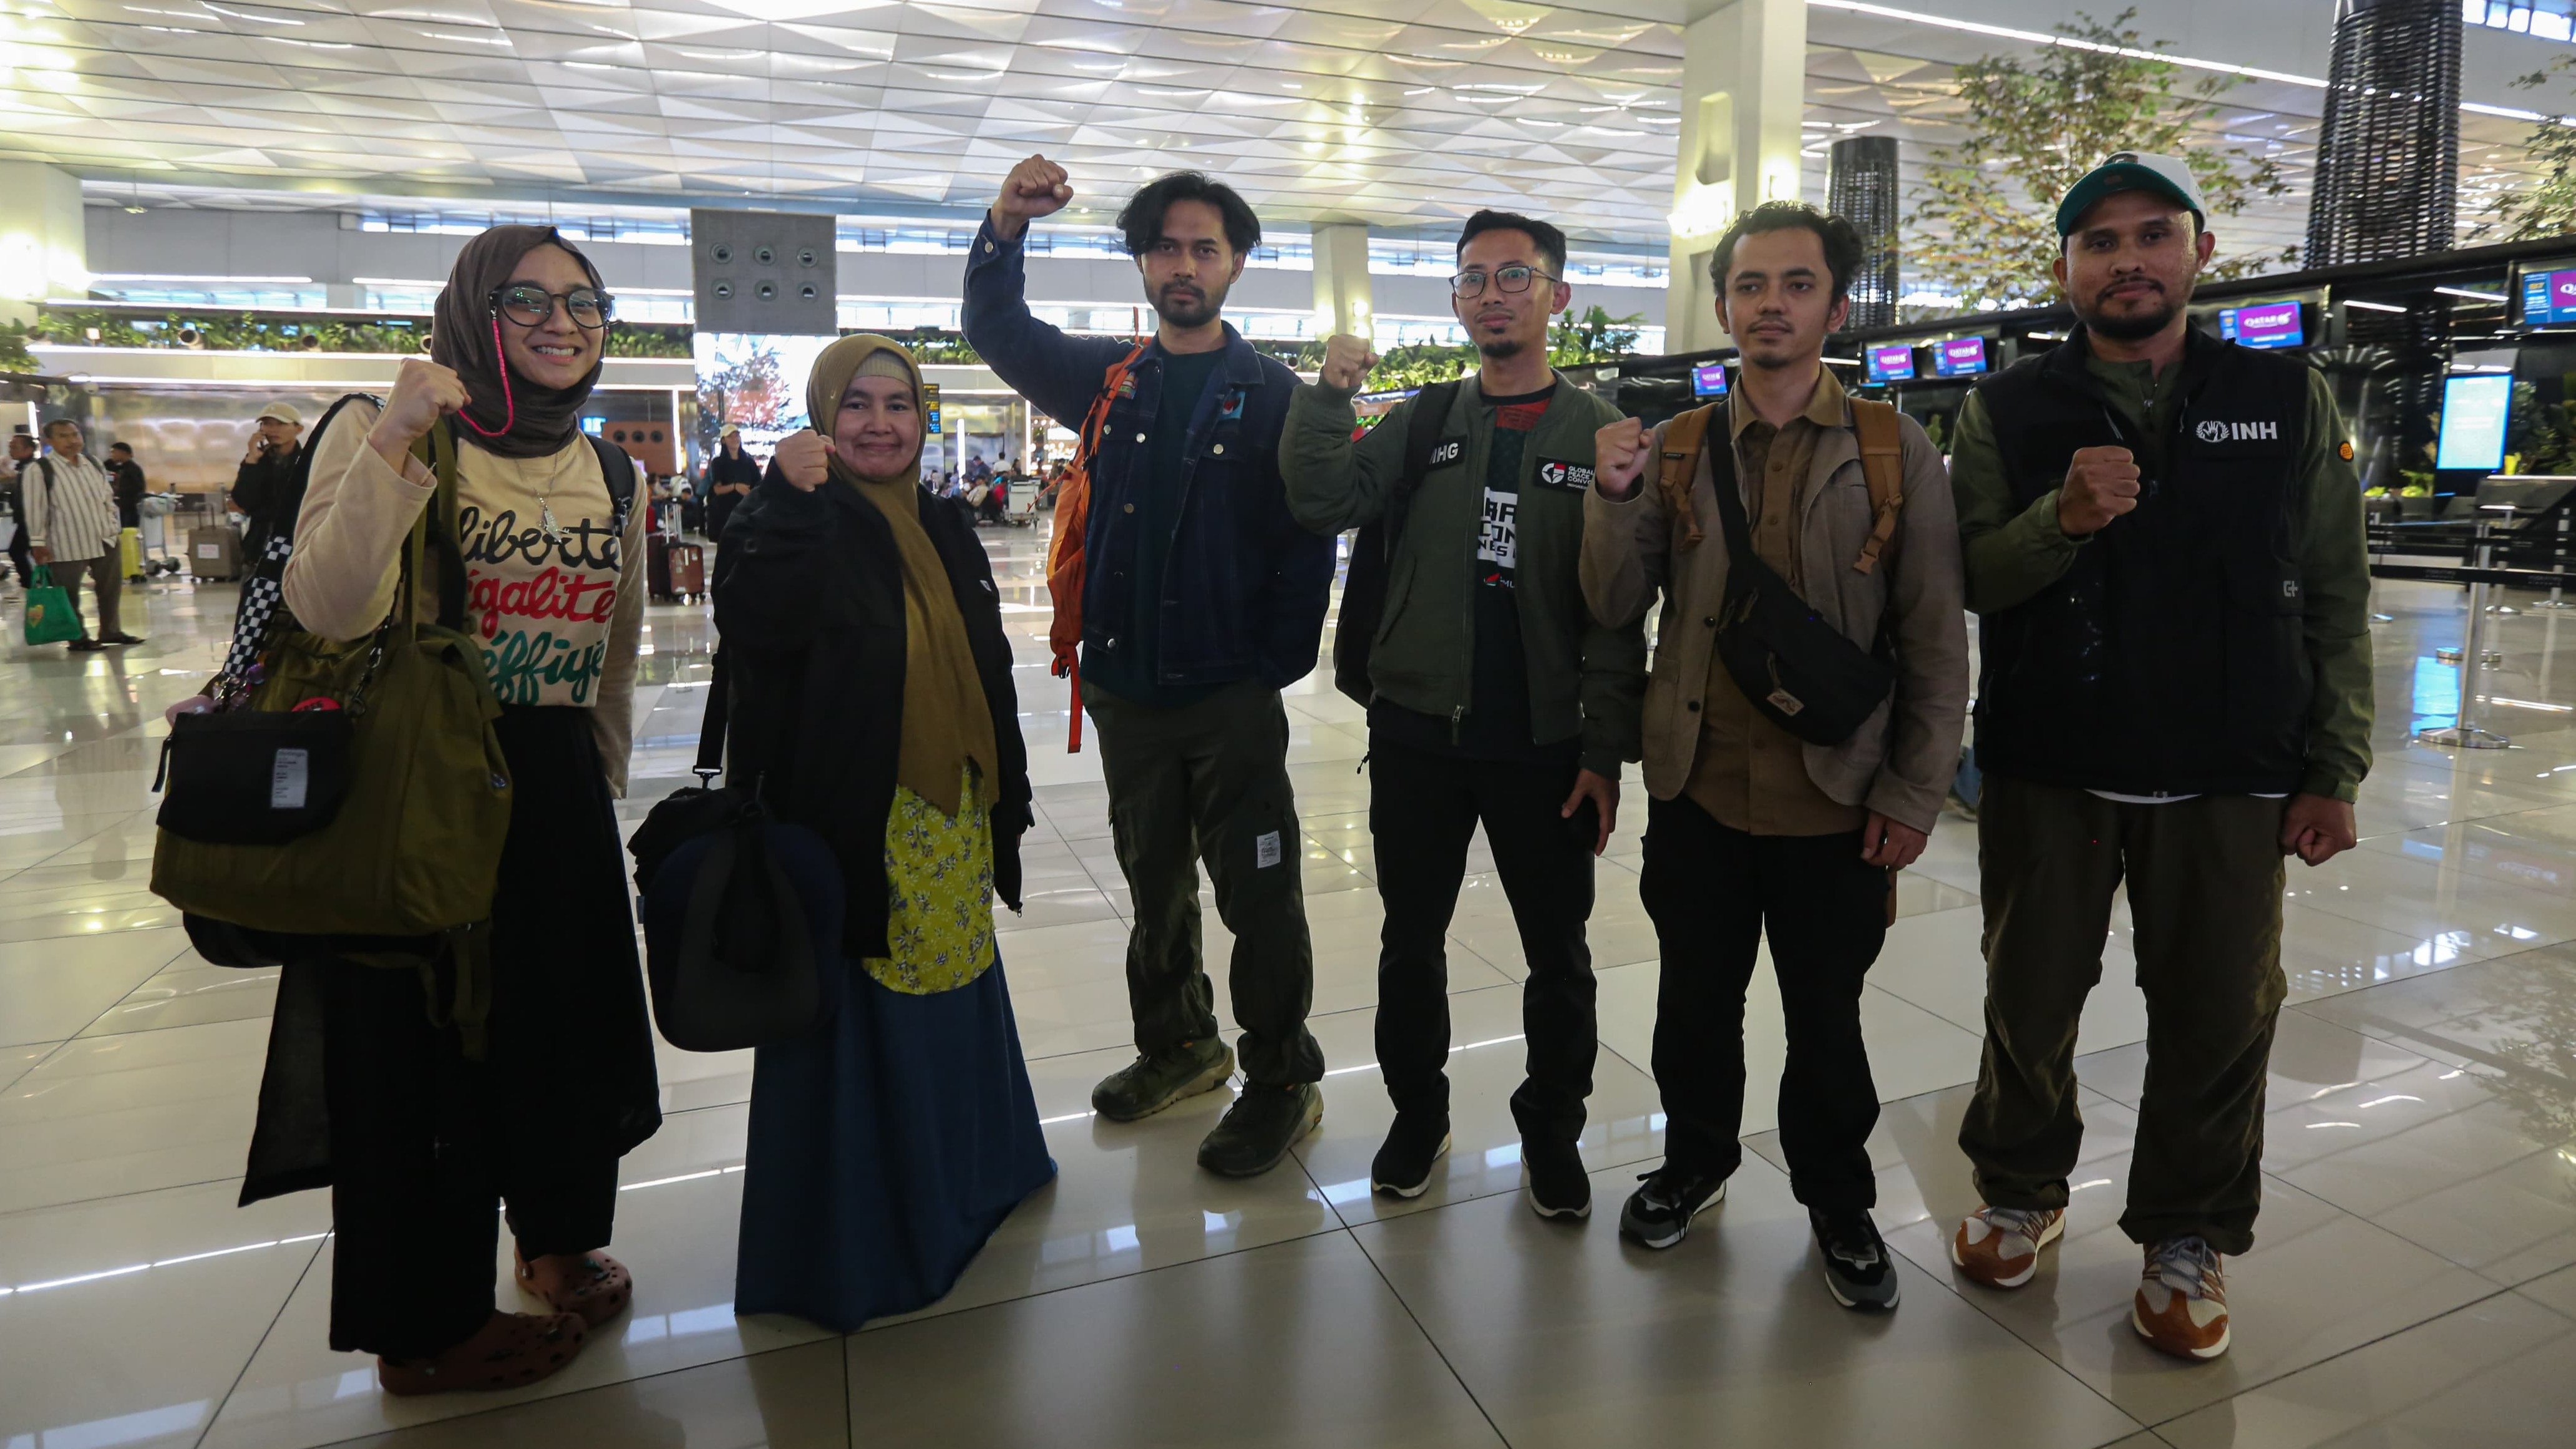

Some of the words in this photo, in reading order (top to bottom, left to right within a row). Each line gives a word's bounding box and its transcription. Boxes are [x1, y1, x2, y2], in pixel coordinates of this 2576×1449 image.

[2243, 315, 2277, 328] QATAR
[2231, 421, 2277, 440] INH
[1568, 466, 1593, 475] GLOBAL
[1568, 471, 1590, 480] PEACE
